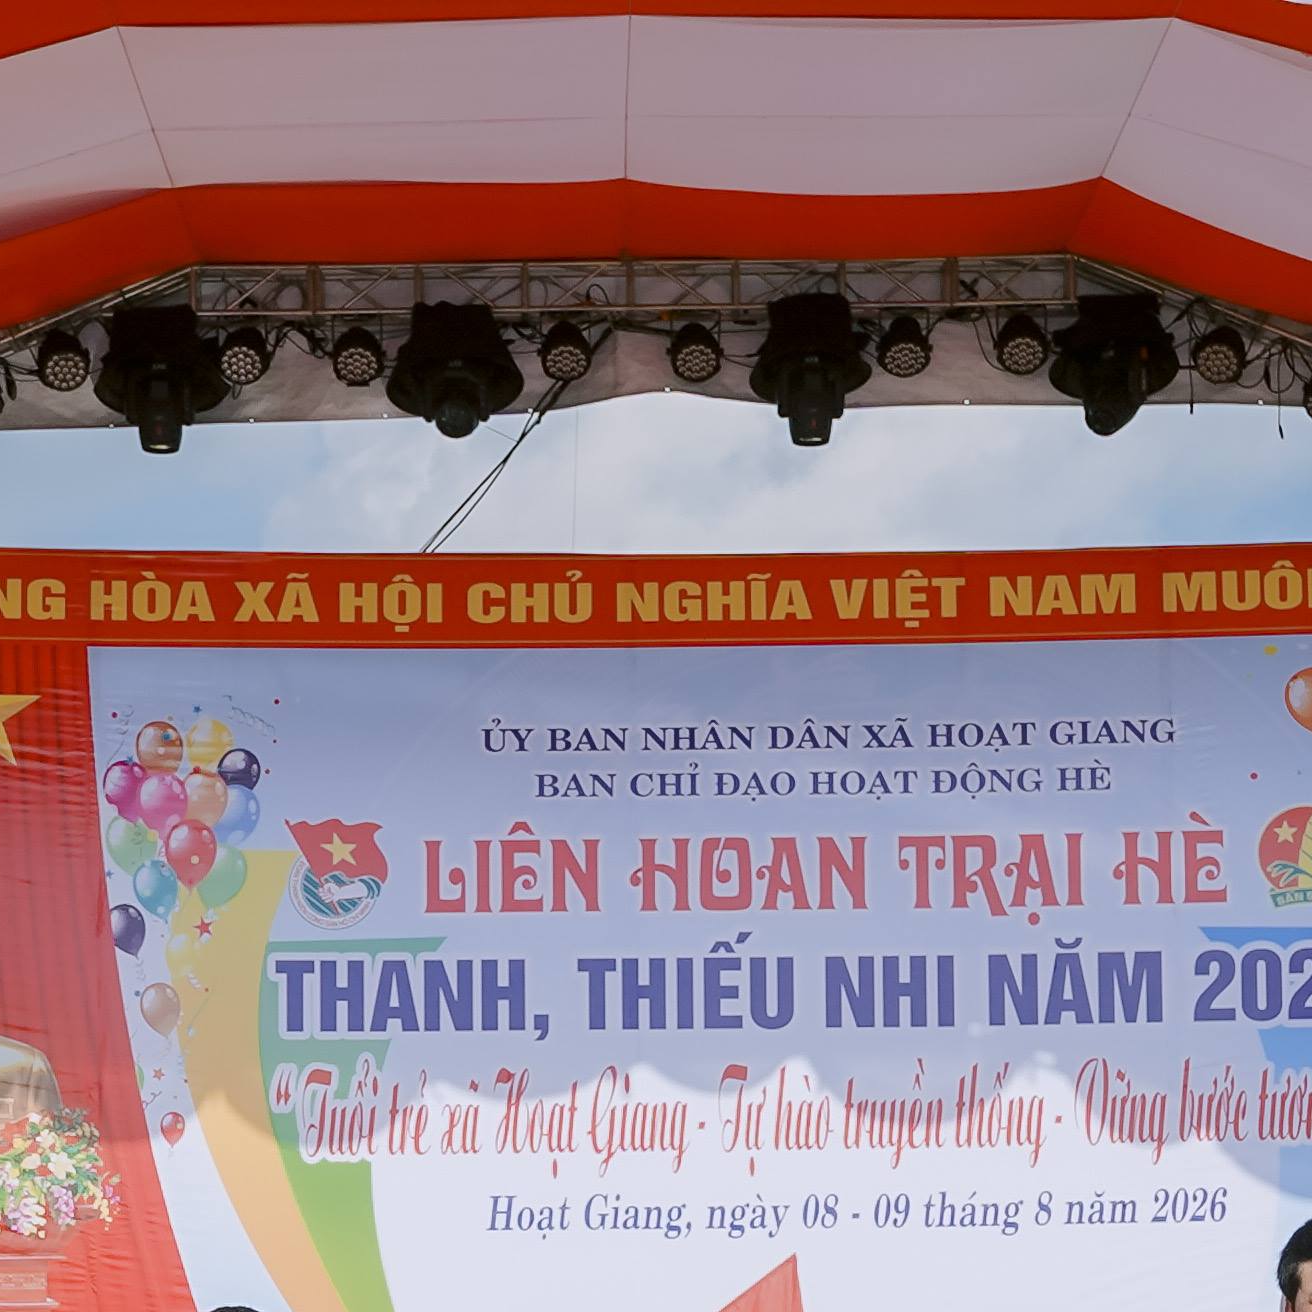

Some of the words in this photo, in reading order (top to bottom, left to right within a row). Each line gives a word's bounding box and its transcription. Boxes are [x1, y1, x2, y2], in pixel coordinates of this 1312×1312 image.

[91, 571, 215, 621] HÒA
[234, 573, 319, 622] XÃ
[339, 575, 442, 632] HỘI
[468, 570, 592, 623] CHỦ
[617, 573, 812, 622] NGHĨA
[830, 570, 965, 627] VIỆT
[990, 574, 1136, 616] NAM
[482, 718, 534, 752] ỦY
[547, 728, 628, 751] BAN
[642, 720, 755, 750] NHÂN
[768, 719, 850, 749] DÂN
[863, 718, 913, 748] XÃ
[928, 723, 1036, 752] HOẠT
[1050, 719, 1175, 745] GIANG
[536, 774, 616, 797] BAN
[631, 762, 699, 797] CHỈ
[714, 772, 795, 801] ĐẠO
[810, 771, 918, 800] HOẠT
[931, 763, 1042, 799] ĐỘNG
[1058, 759, 1110, 791] HÈ
[424, 820, 601, 914] LIÊN
[630, 837, 866, 911] HOAN
[898, 832, 1083, 925] TRẠI
[1113, 812, 1227, 905] HÈ
[276, 959, 549, 1041] THANH,
[577, 932, 794, 1030] THIẾU
[825, 955, 954, 1028] NHI
[988, 938, 1163, 1026] NĂM
[275, 1058, 377, 1156] “Tuổi
[388, 1069, 431, 1155] trẻ
[440, 1079, 481, 1155] xã
[493, 1067, 580, 1178] Hoạt
[587, 1064, 689, 1177] Giang
[718, 1063, 766, 1176] Tự
[773, 1065, 833, 1150] hào
[843, 1057, 946, 1169] truyền
[955, 1061, 1045, 1168] thống
[1074, 1057, 1169, 1165] Vững
[1178, 1056, 1248, 1141] bước
[487, 1196, 569, 1239] Hoạt
[585, 1194, 691, 1239] Giang,
[706, 1194, 789, 1238] ngày
[803, 1194, 838, 1228] 08
[874, 1194, 910, 1228] 09
[924, 1191, 1023, 1236] tháng
[1035, 1191, 1052, 1225] 8
[1065, 1192, 1136, 1224] năm
[1151, 1187, 1227, 1223] 2026
